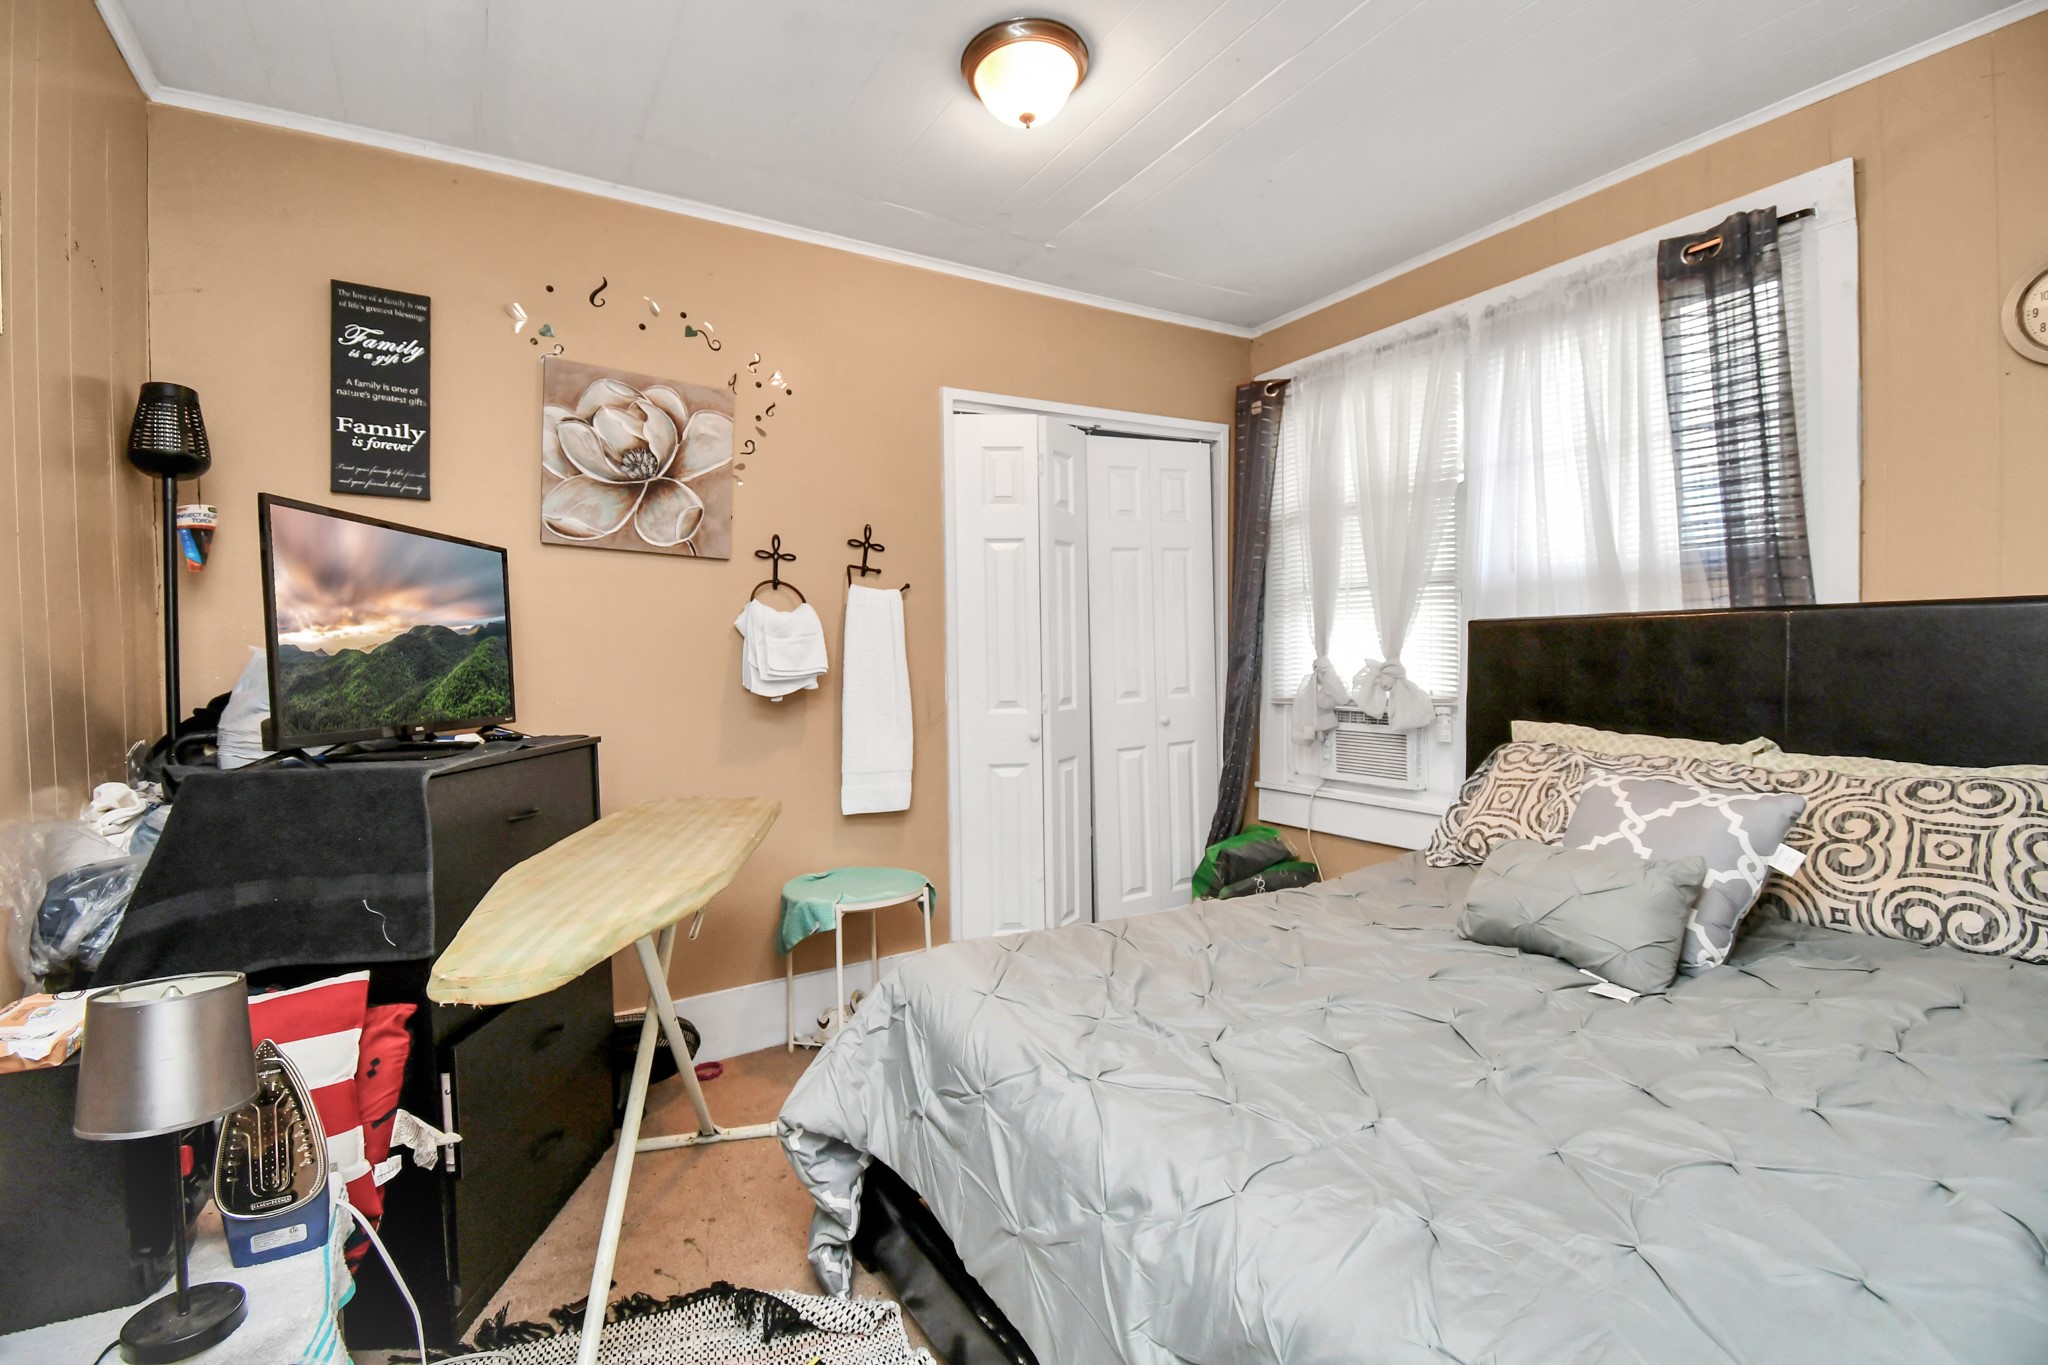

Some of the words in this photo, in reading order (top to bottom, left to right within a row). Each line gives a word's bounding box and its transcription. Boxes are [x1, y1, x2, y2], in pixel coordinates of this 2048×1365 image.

[337, 288, 351, 297] The
[352, 291, 367, 300] love
[368, 294, 377, 302] of
[384, 297, 406, 309] family
[348, 301, 365, 310] life's
[365, 306, 393, 315] greatest
[394, 309, 426, 322] blessings
[2032, 308, 2039, 318] 9
[2040, 322, 2046, 333] 8
[338, 324, 425, 364] Family
[348, 349, 360, 358] is
[371, 353, 399, 366] gift
[346, 378, 353, 386] A
[354, 379, 381, 391] family
[383, 383, 390, 391] is
[391, 386, 408, 394] one
[336, 388, 370, 399] nature's
[372, 393, 406, 404] greatest
[408, 398, 427, 407] gifts
[336, 416, 426, 445] Family
[351, 436, 363, 447] is
[362, 437, 414, 452] forever
